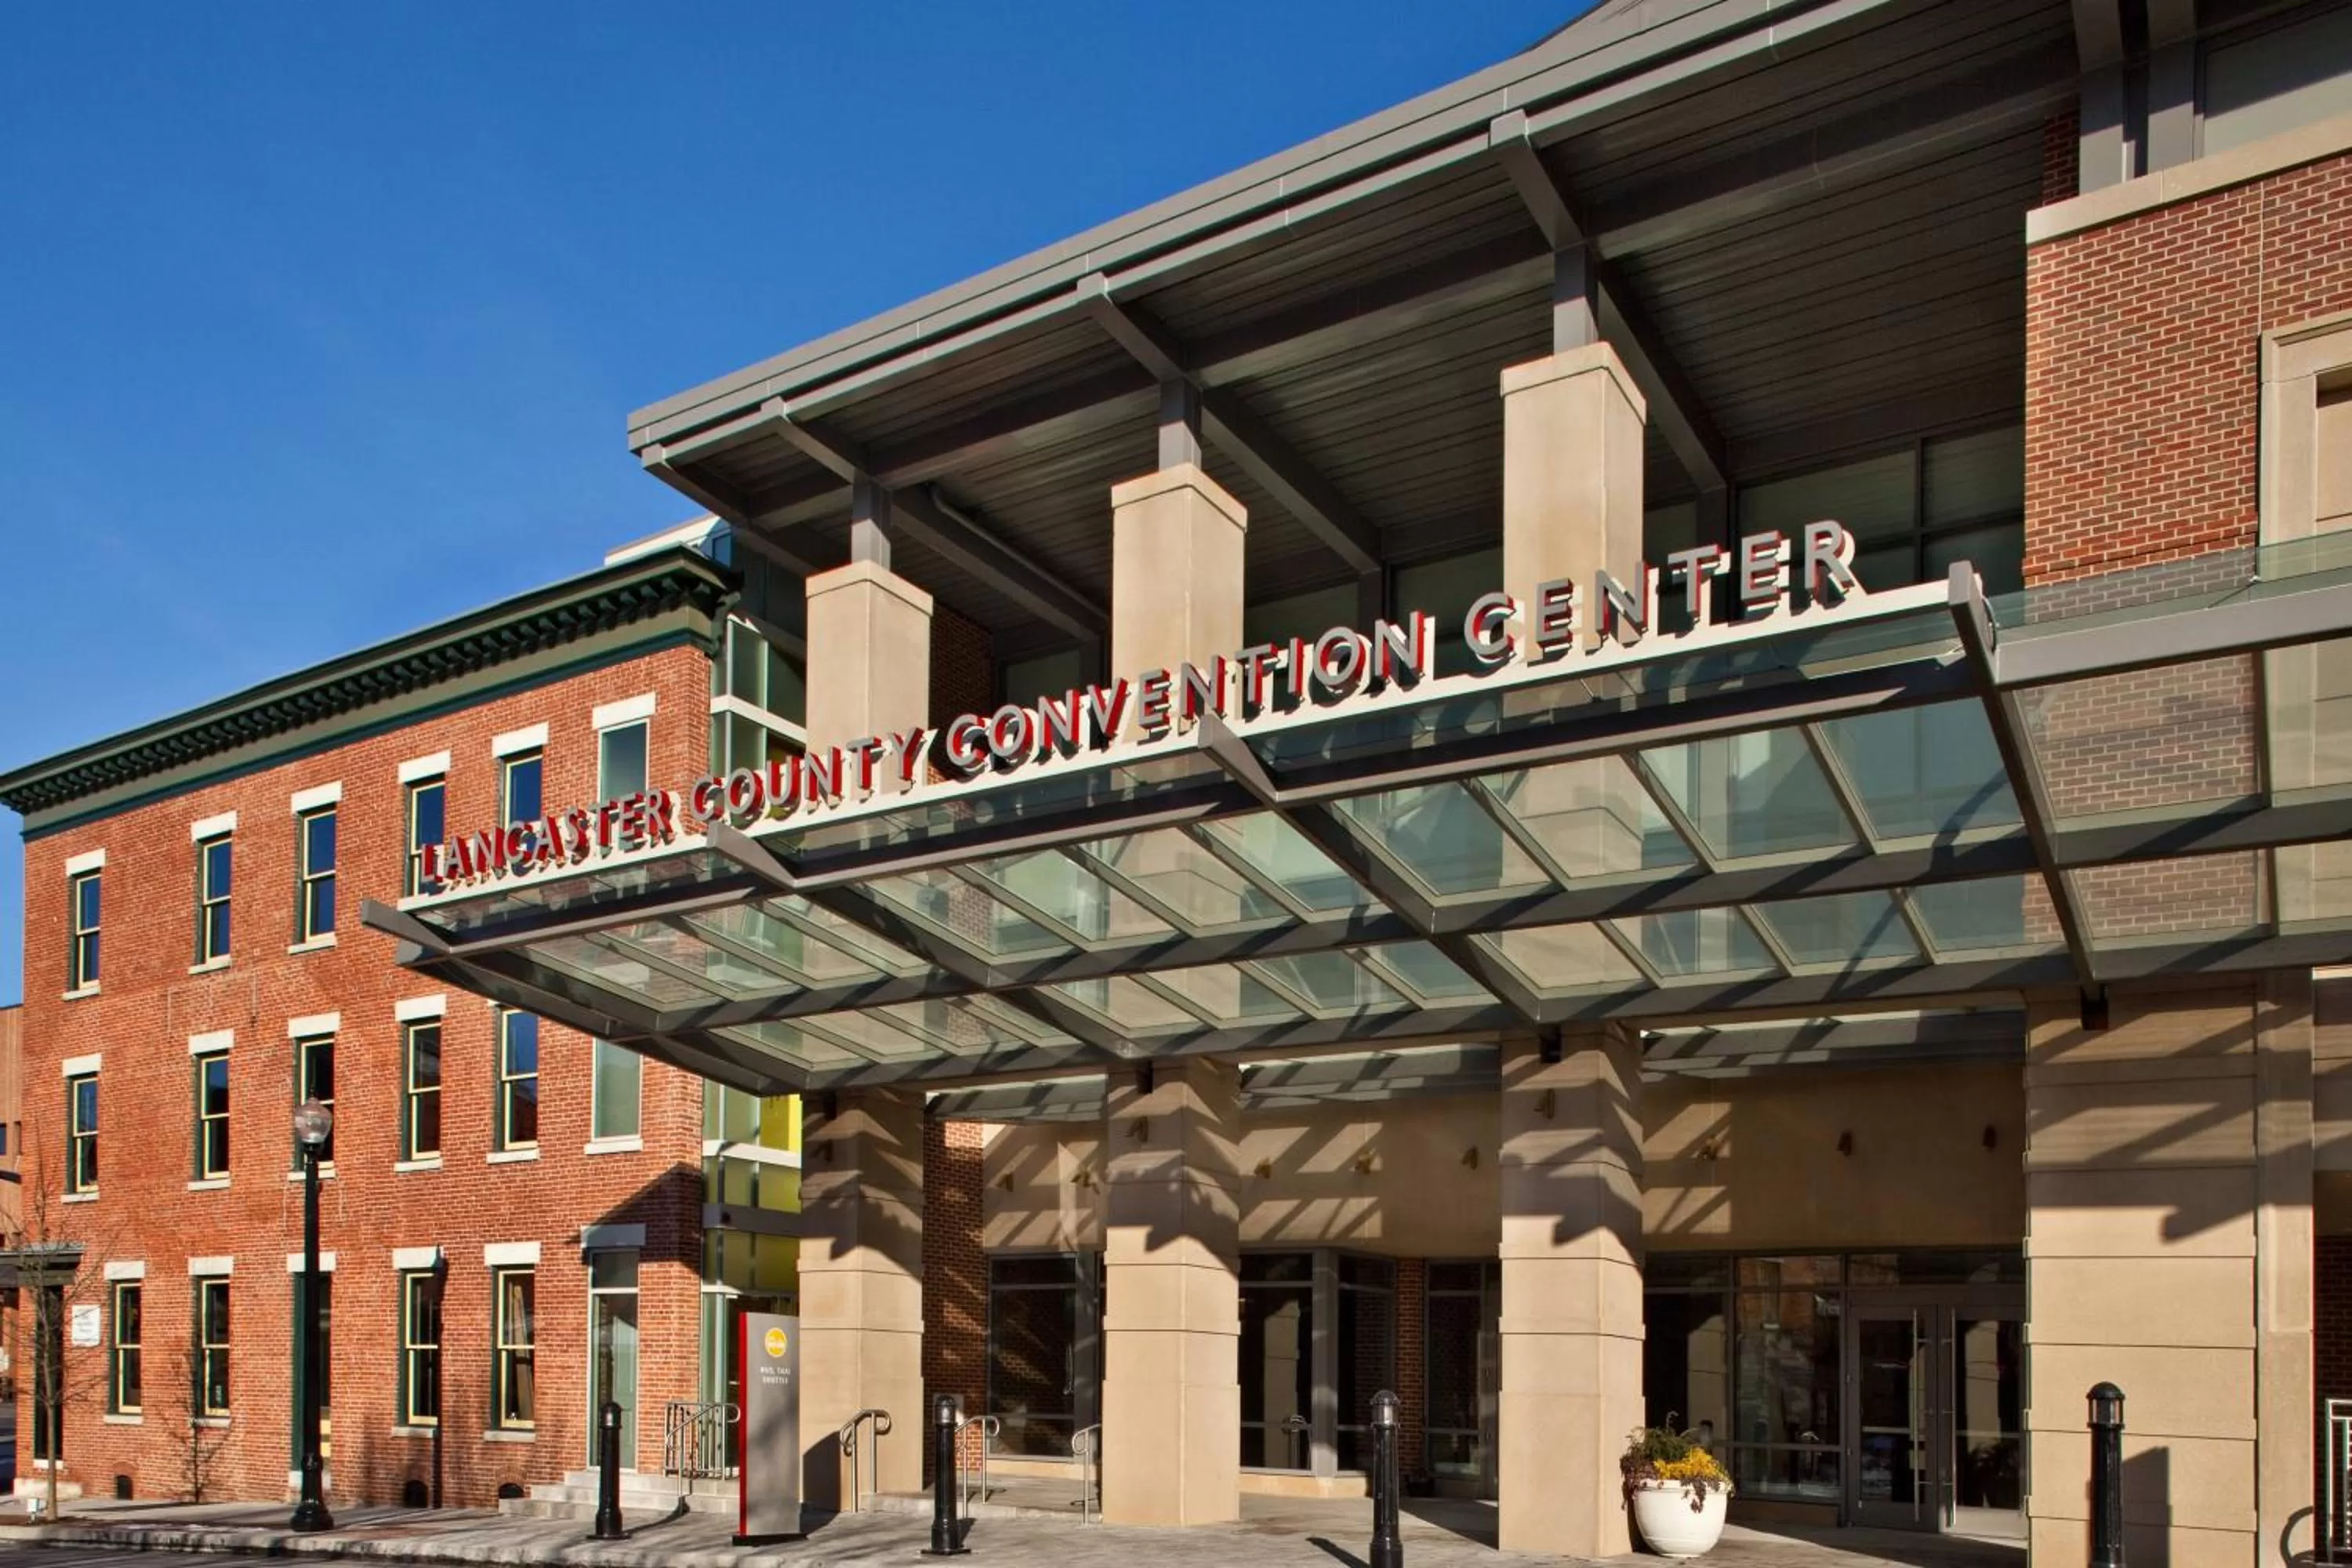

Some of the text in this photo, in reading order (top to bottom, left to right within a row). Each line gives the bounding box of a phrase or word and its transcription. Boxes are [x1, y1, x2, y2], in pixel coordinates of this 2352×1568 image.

[420, 519, 1854, 883] LANCASTER COUNTY CONVENTION CENTER
